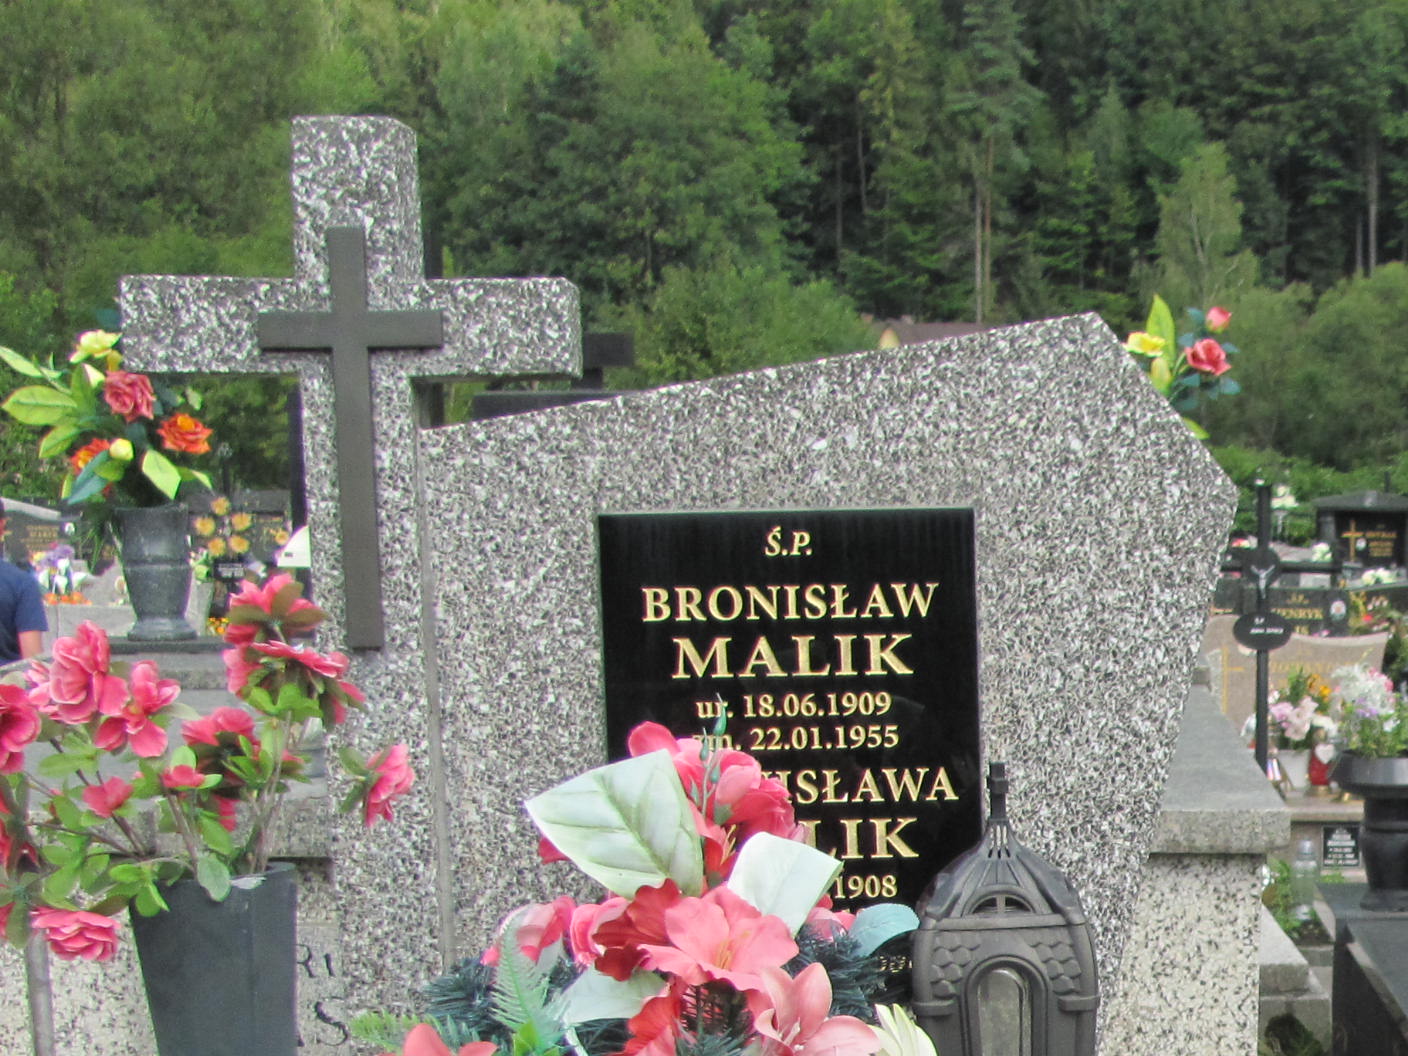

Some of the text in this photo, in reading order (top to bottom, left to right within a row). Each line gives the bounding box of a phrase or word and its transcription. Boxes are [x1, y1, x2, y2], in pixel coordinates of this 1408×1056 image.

[765, 526, 814, 557] Ś.P.
[641, 581, 939, 623] BRONISŁAW
[672, 633, 914, 679] MALIK
[743, 692, 893, 719] 18.06.1909
[750, 725, 900, 751] 22.01.1955
[798, 817, 920, 859] LIK
[833, 874, 899, 898] 1908
